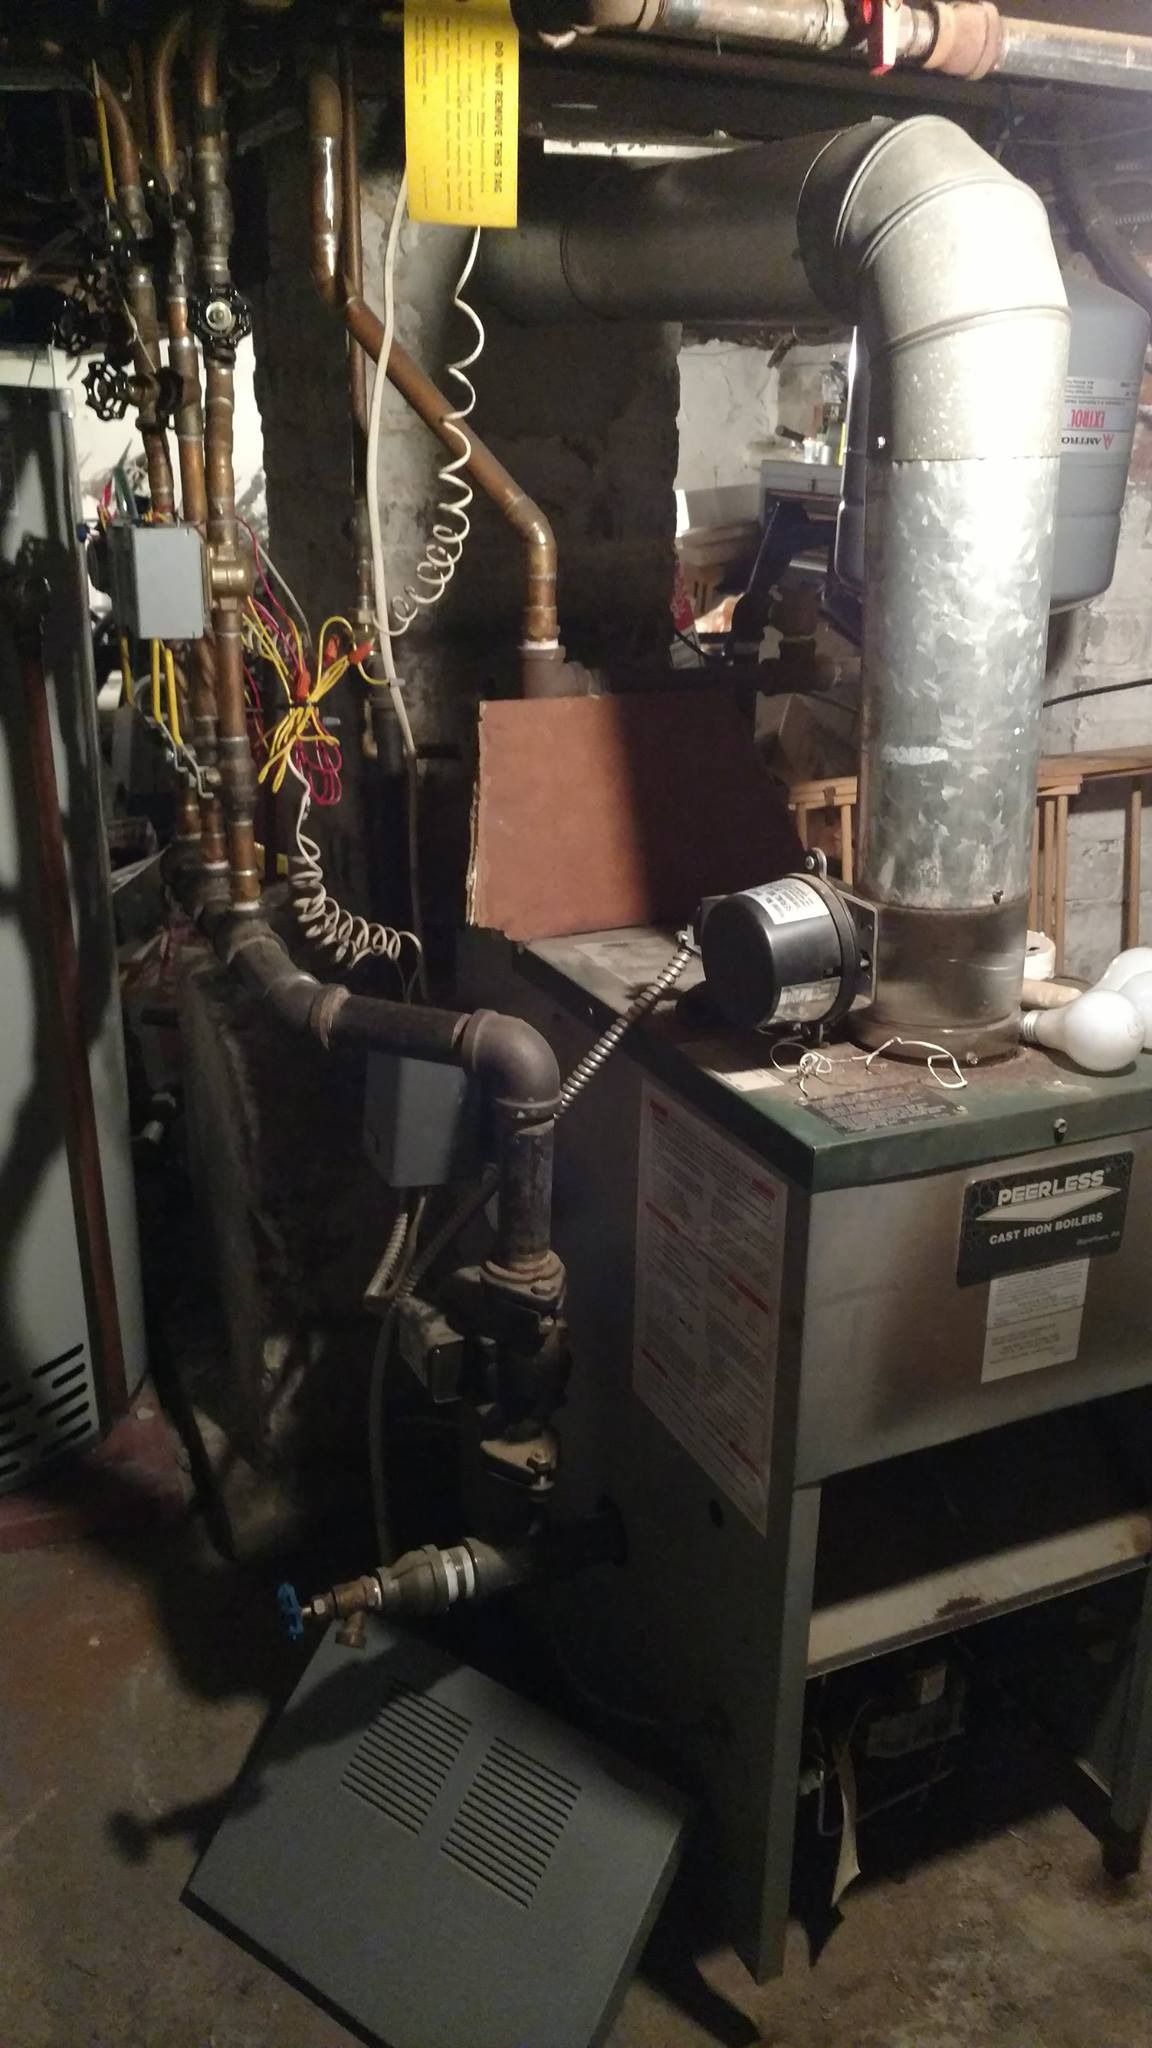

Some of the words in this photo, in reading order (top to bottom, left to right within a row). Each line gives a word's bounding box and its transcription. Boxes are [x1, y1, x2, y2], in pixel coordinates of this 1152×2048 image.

[494, 40, 504, 57] DO
[494, 63, 504, 85] NOT
[494, 90, 504, 137] REMOVE
[494, 142, 503, 167] THIS
[494, 171, 503, 193] TAG
[997, 1169, 1105, 1206] PEERLESS
[989, 1229, 1021, 1245] CAST
[1023, 1222, 1052, 1238] IRON
[1055, 1212, 1104, 1231] BOILERS
